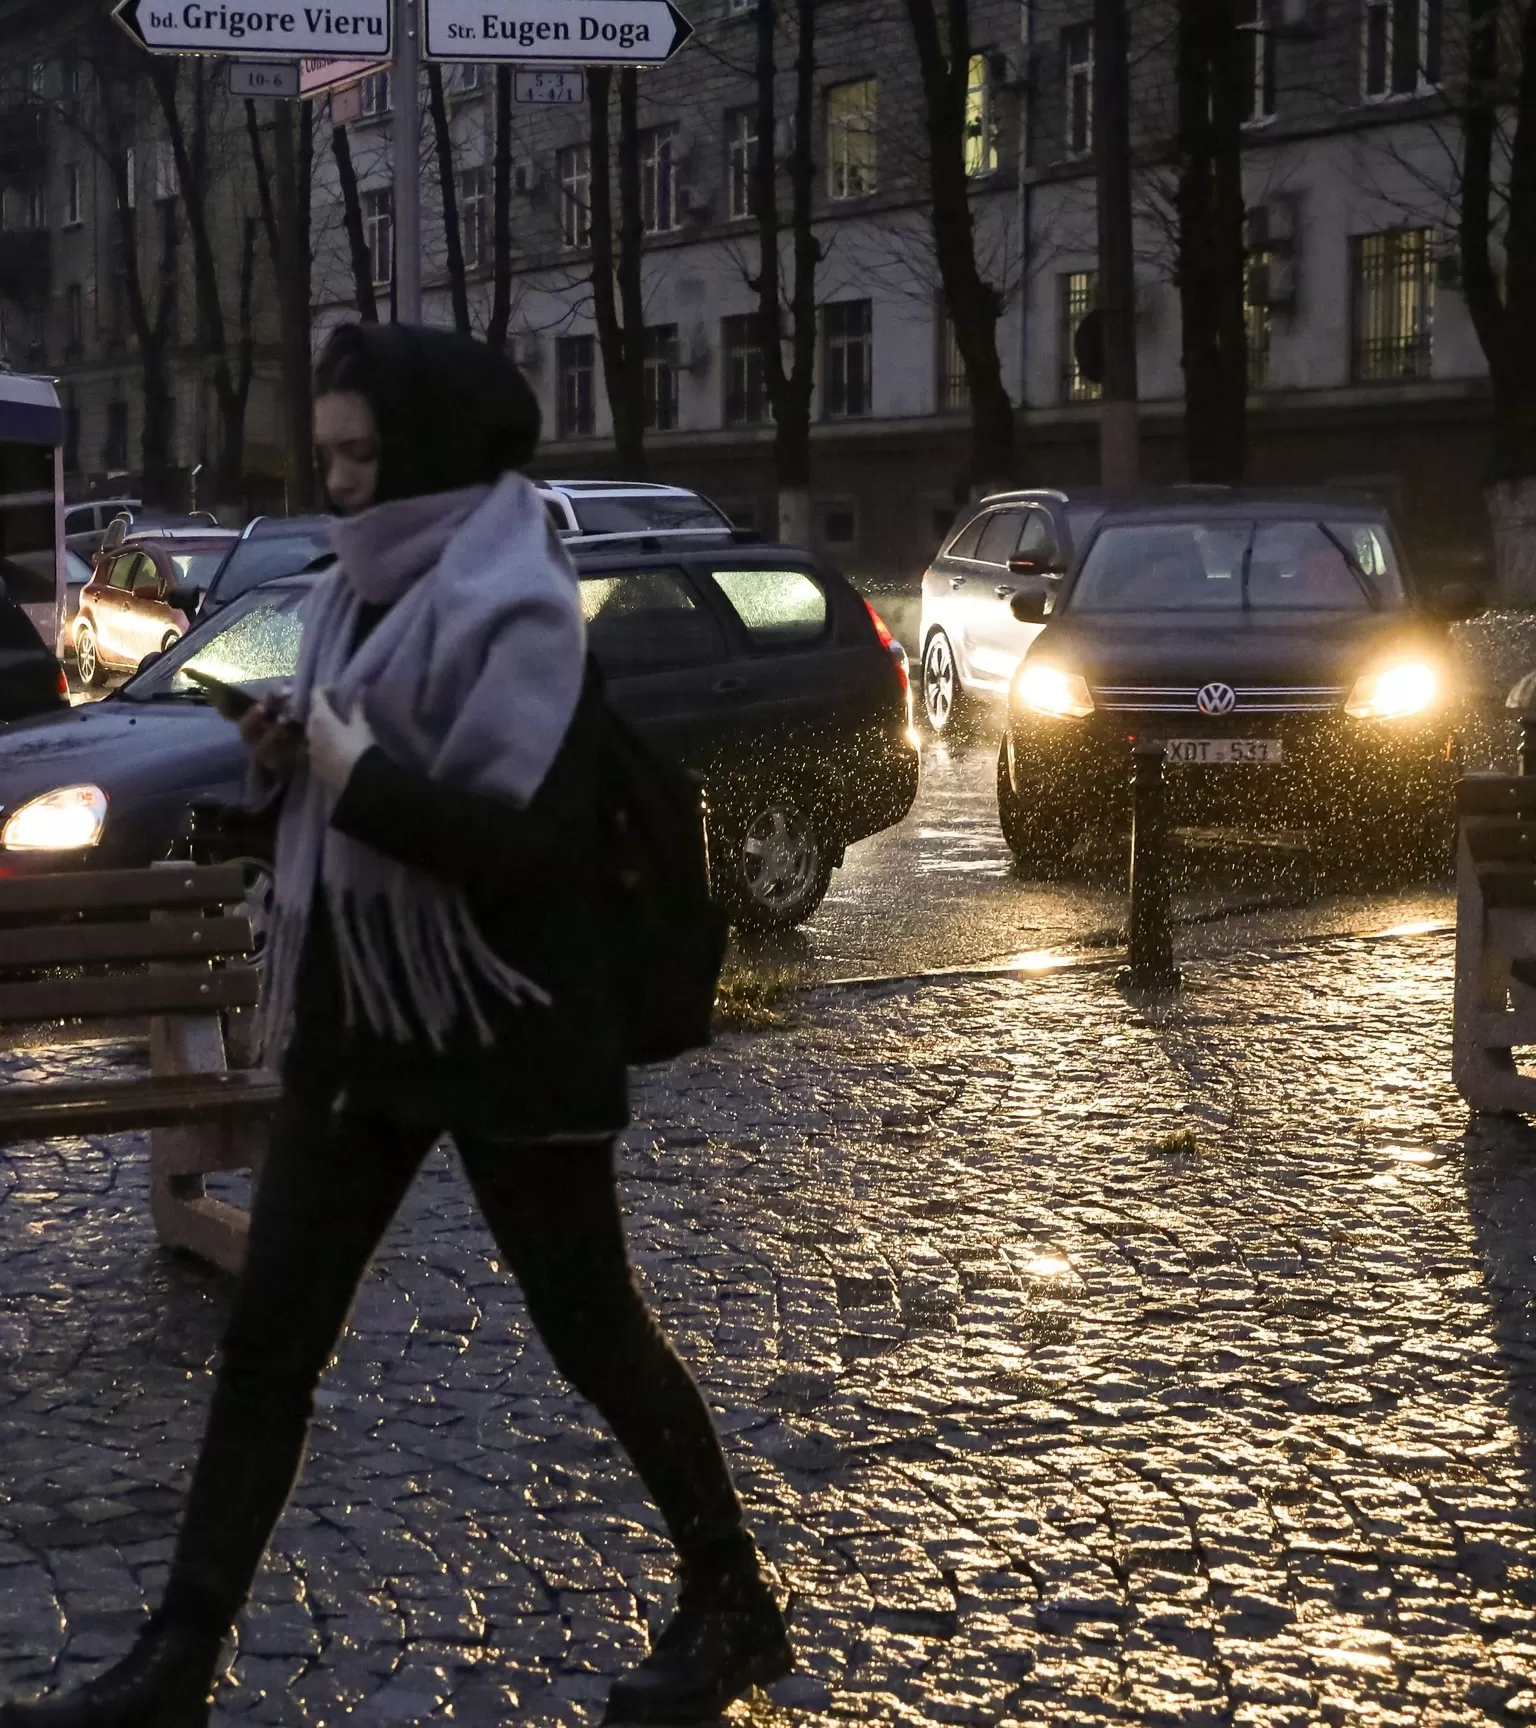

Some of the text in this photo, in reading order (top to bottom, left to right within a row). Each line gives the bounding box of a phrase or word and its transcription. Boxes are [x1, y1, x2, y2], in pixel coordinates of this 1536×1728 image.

[150, 4, 384, 37] bd. Grigore Vieru
[447, 15, 651, 48] Str. Eugen Doga
[1170, 742, 1211, 761] XDT
